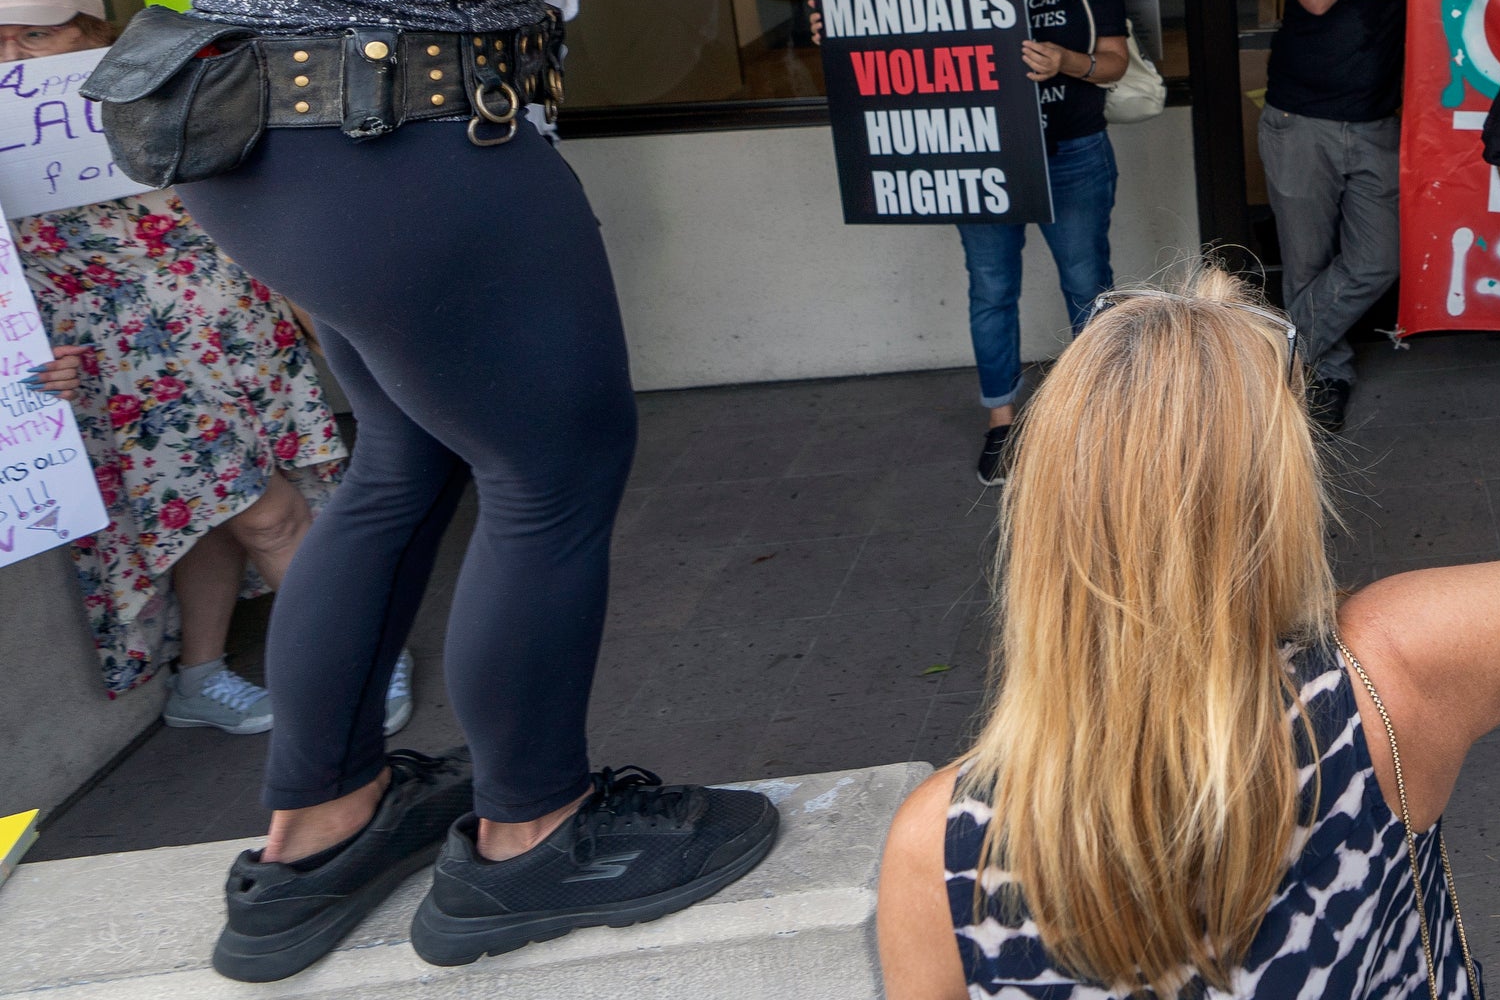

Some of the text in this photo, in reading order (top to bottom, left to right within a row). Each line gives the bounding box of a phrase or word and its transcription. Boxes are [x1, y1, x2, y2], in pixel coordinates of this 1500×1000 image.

[850, 45, 999, 95] VIOLATE
[864, 106, 1001, 155] HUMAN
[872, 167, 1010, 216] RIGHTS
[34, 448, 78, 470] OLD
